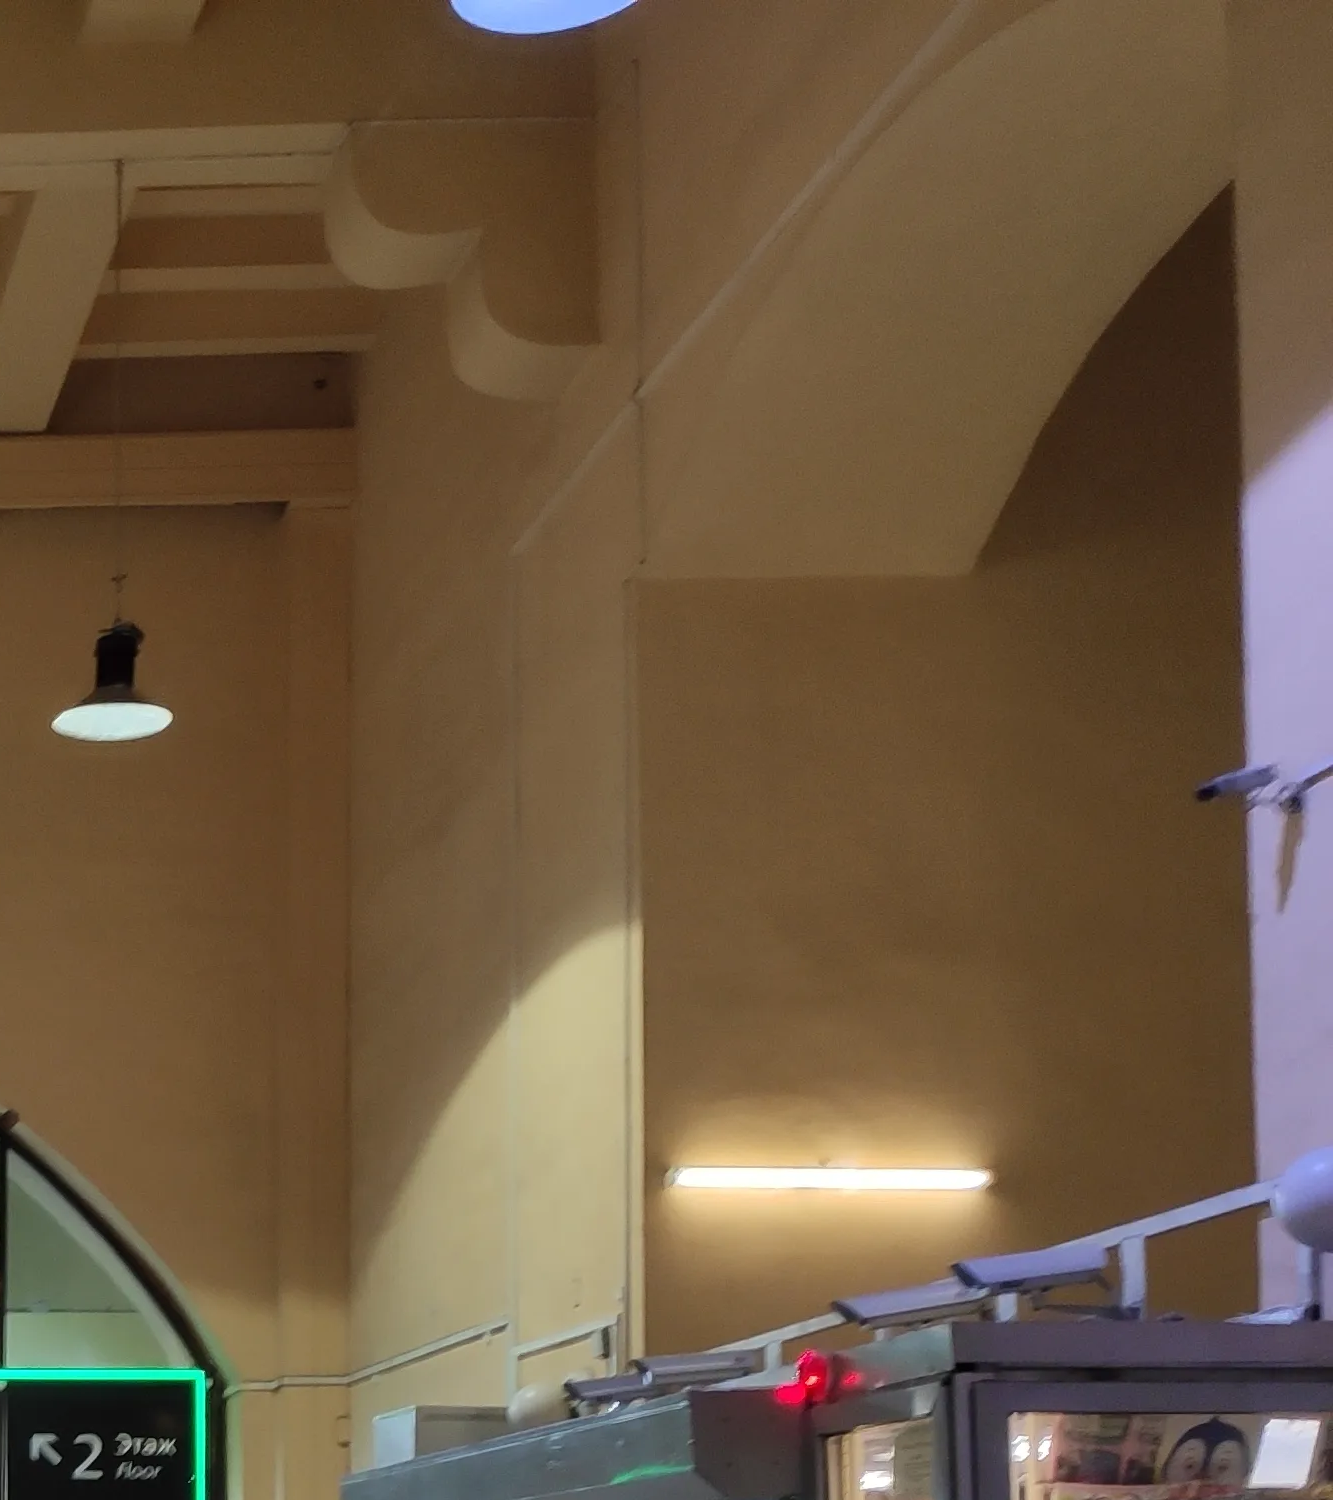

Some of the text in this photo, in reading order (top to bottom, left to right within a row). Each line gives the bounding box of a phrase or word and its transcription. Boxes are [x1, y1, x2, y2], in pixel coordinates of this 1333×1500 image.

[71, 1433, 104, 1480] 2
[114, 1432, 178, 1457] Этаж
[114, 1461, 163, 1480] Floor
